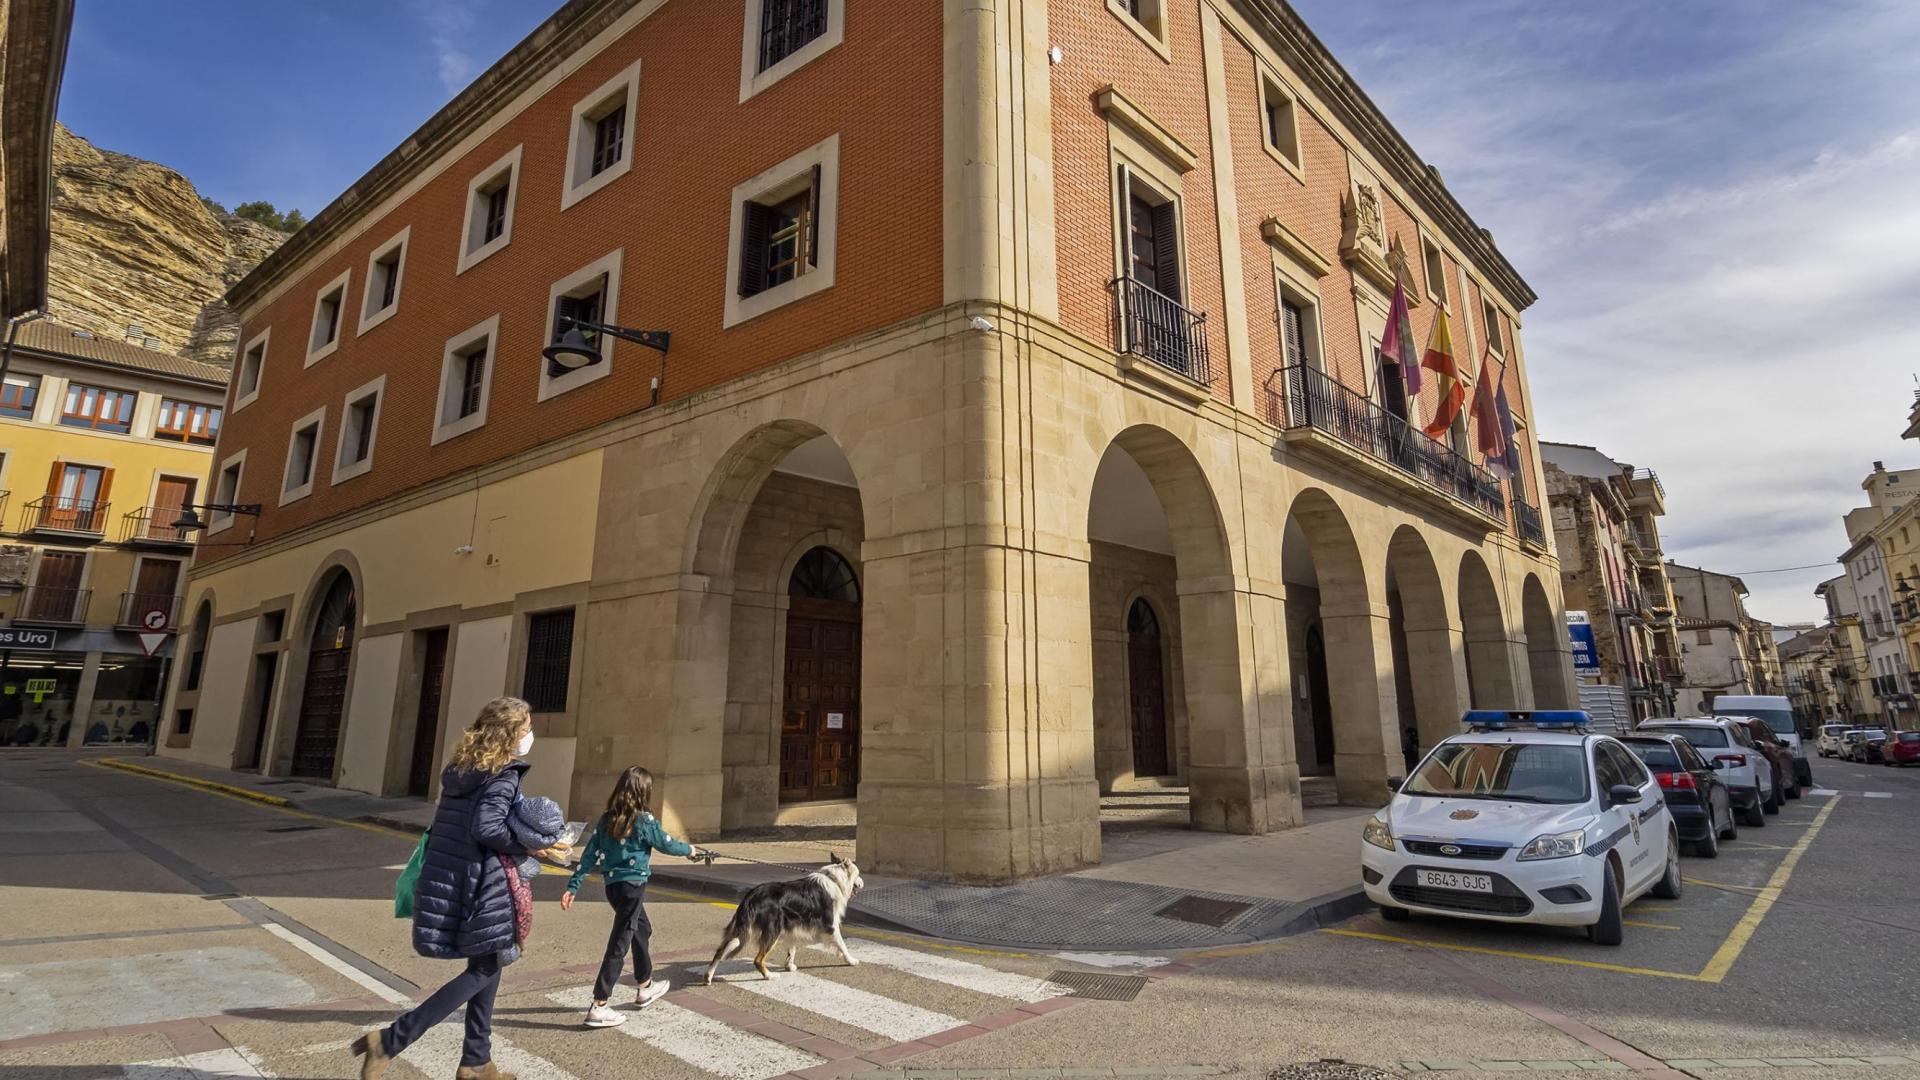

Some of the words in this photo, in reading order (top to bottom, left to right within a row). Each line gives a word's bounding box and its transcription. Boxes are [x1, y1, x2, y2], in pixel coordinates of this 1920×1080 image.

[18, 631, 48, 644] Uro
[1427, 872, 1457, 887] 6643
[1463, 876, 1486, 890] GJG
